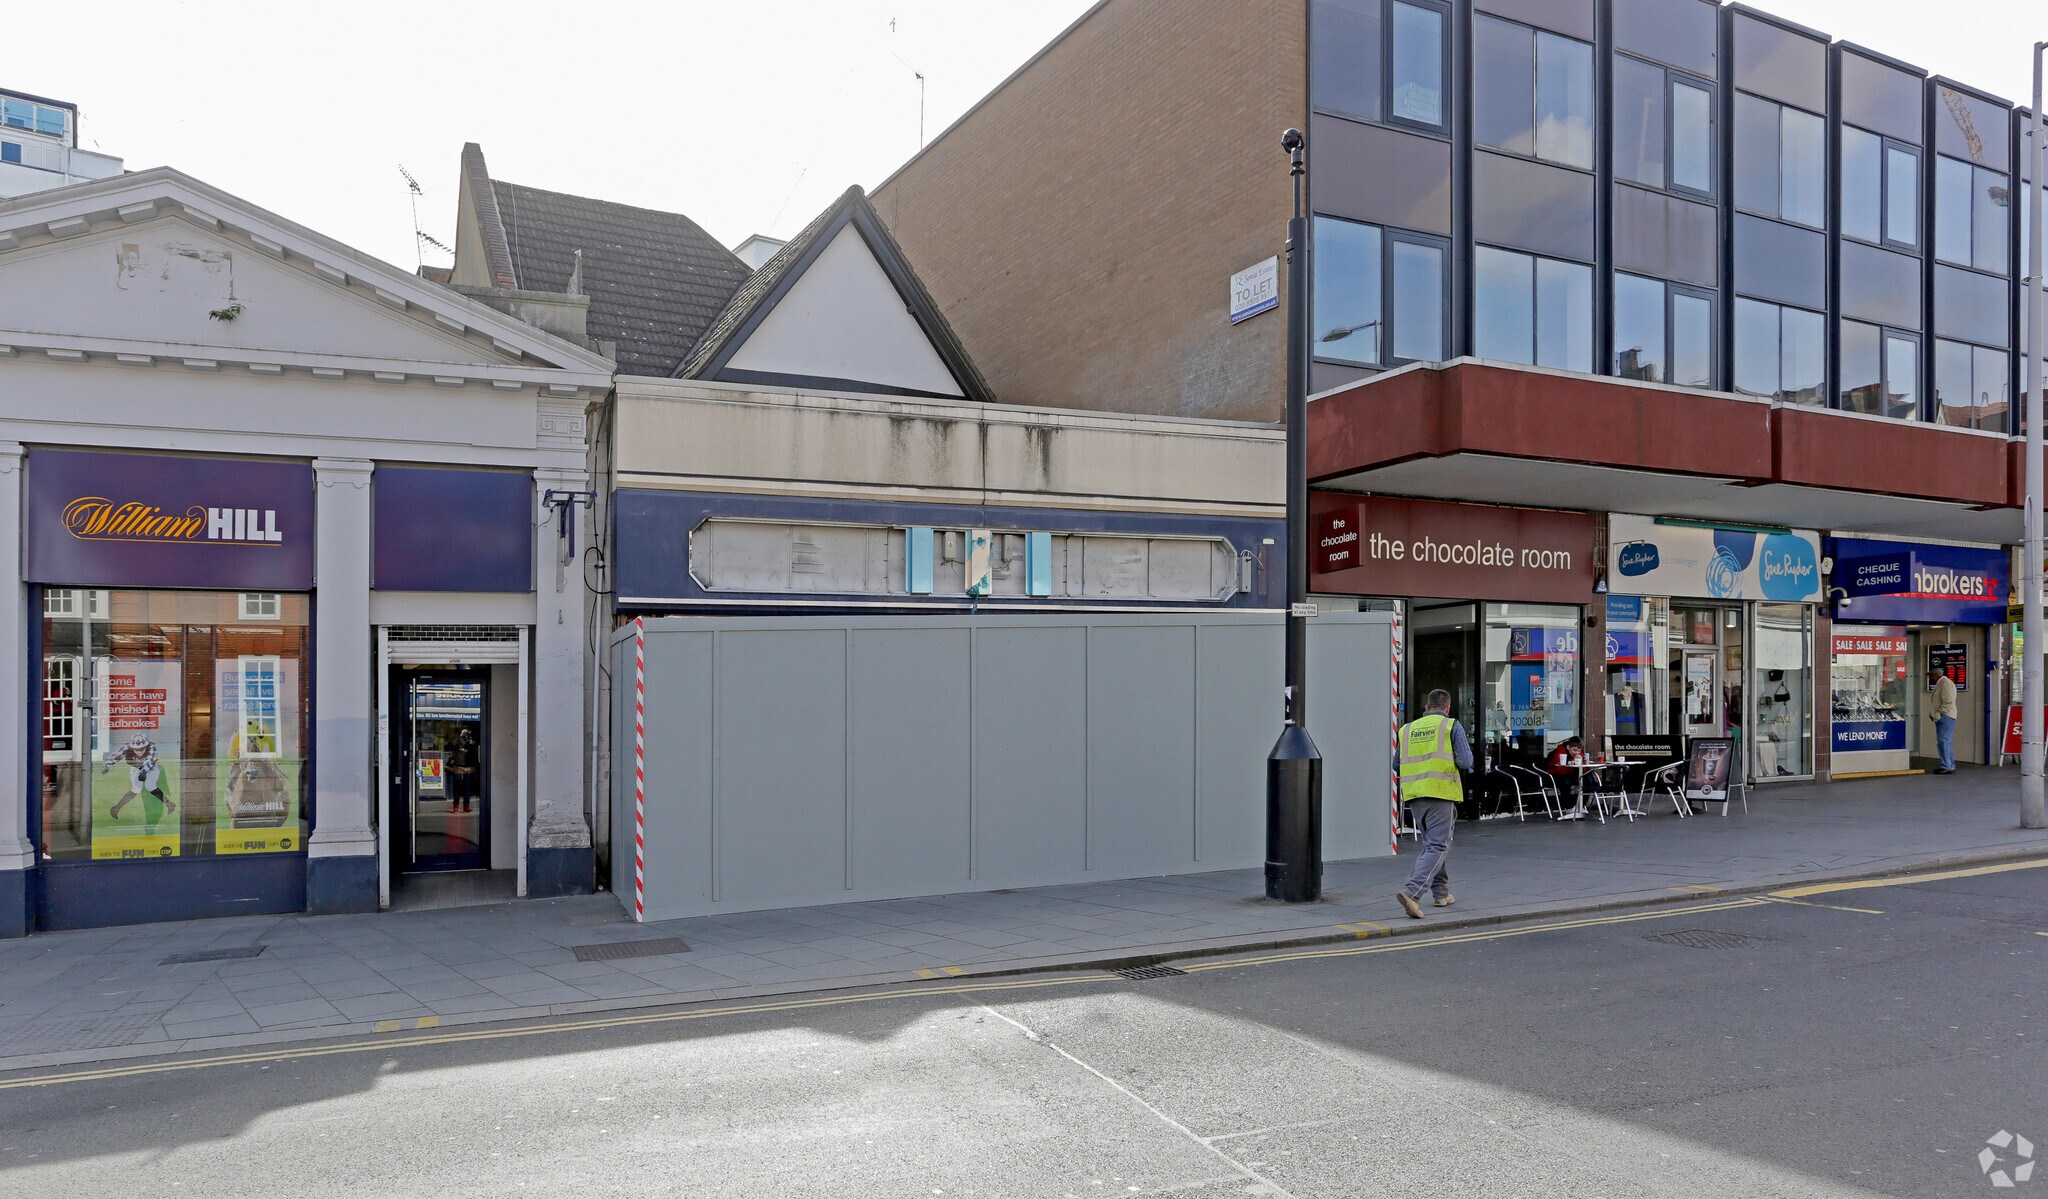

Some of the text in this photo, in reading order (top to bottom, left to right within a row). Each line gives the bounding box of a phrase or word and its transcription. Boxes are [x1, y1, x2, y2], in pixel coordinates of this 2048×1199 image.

[1236, 277, 1273, 303] TO LET
[61, 496, 283, 541] William HILL
[1333, 519, 1345, 529] the
[1320, 532, 1358, 547] chocolate
[1329, 550, 1349, 562] room
[1369, 532, 1571, 570] the chocolate room
[1621, 552, 1656, 568] Sue Ryder
[1764, 550, 1813, 585] Sue Ryder
[1857, 562, 1900, 575] CHEQUE
[1856, 574, 1902, 587] CASHING
[1836, 640, 1853, 650] SALE
[1856, 640, 1873, 651] SALE
[1875, 641, 1892, 651] SALE
[103, 678, 133, 686] Some
[103, 690, 165, 700] horses have
[103, 704, 162, 714] vanished at
[102, 718, 156, 728] Ladbrokes
[1410, 728, 1437, 739] Fairview
[1837, 731, 1888, 741] WE LEND MONEY
[1614, 743, 1626, 751] the
[1625, 743, 1654, 751] chocolate
[265, 801, 285, 811] HILL
[244, 841, 266, 850] FUN
[121, 848, 145, 859] FUN
[160, 848, 172, 856] STOP
